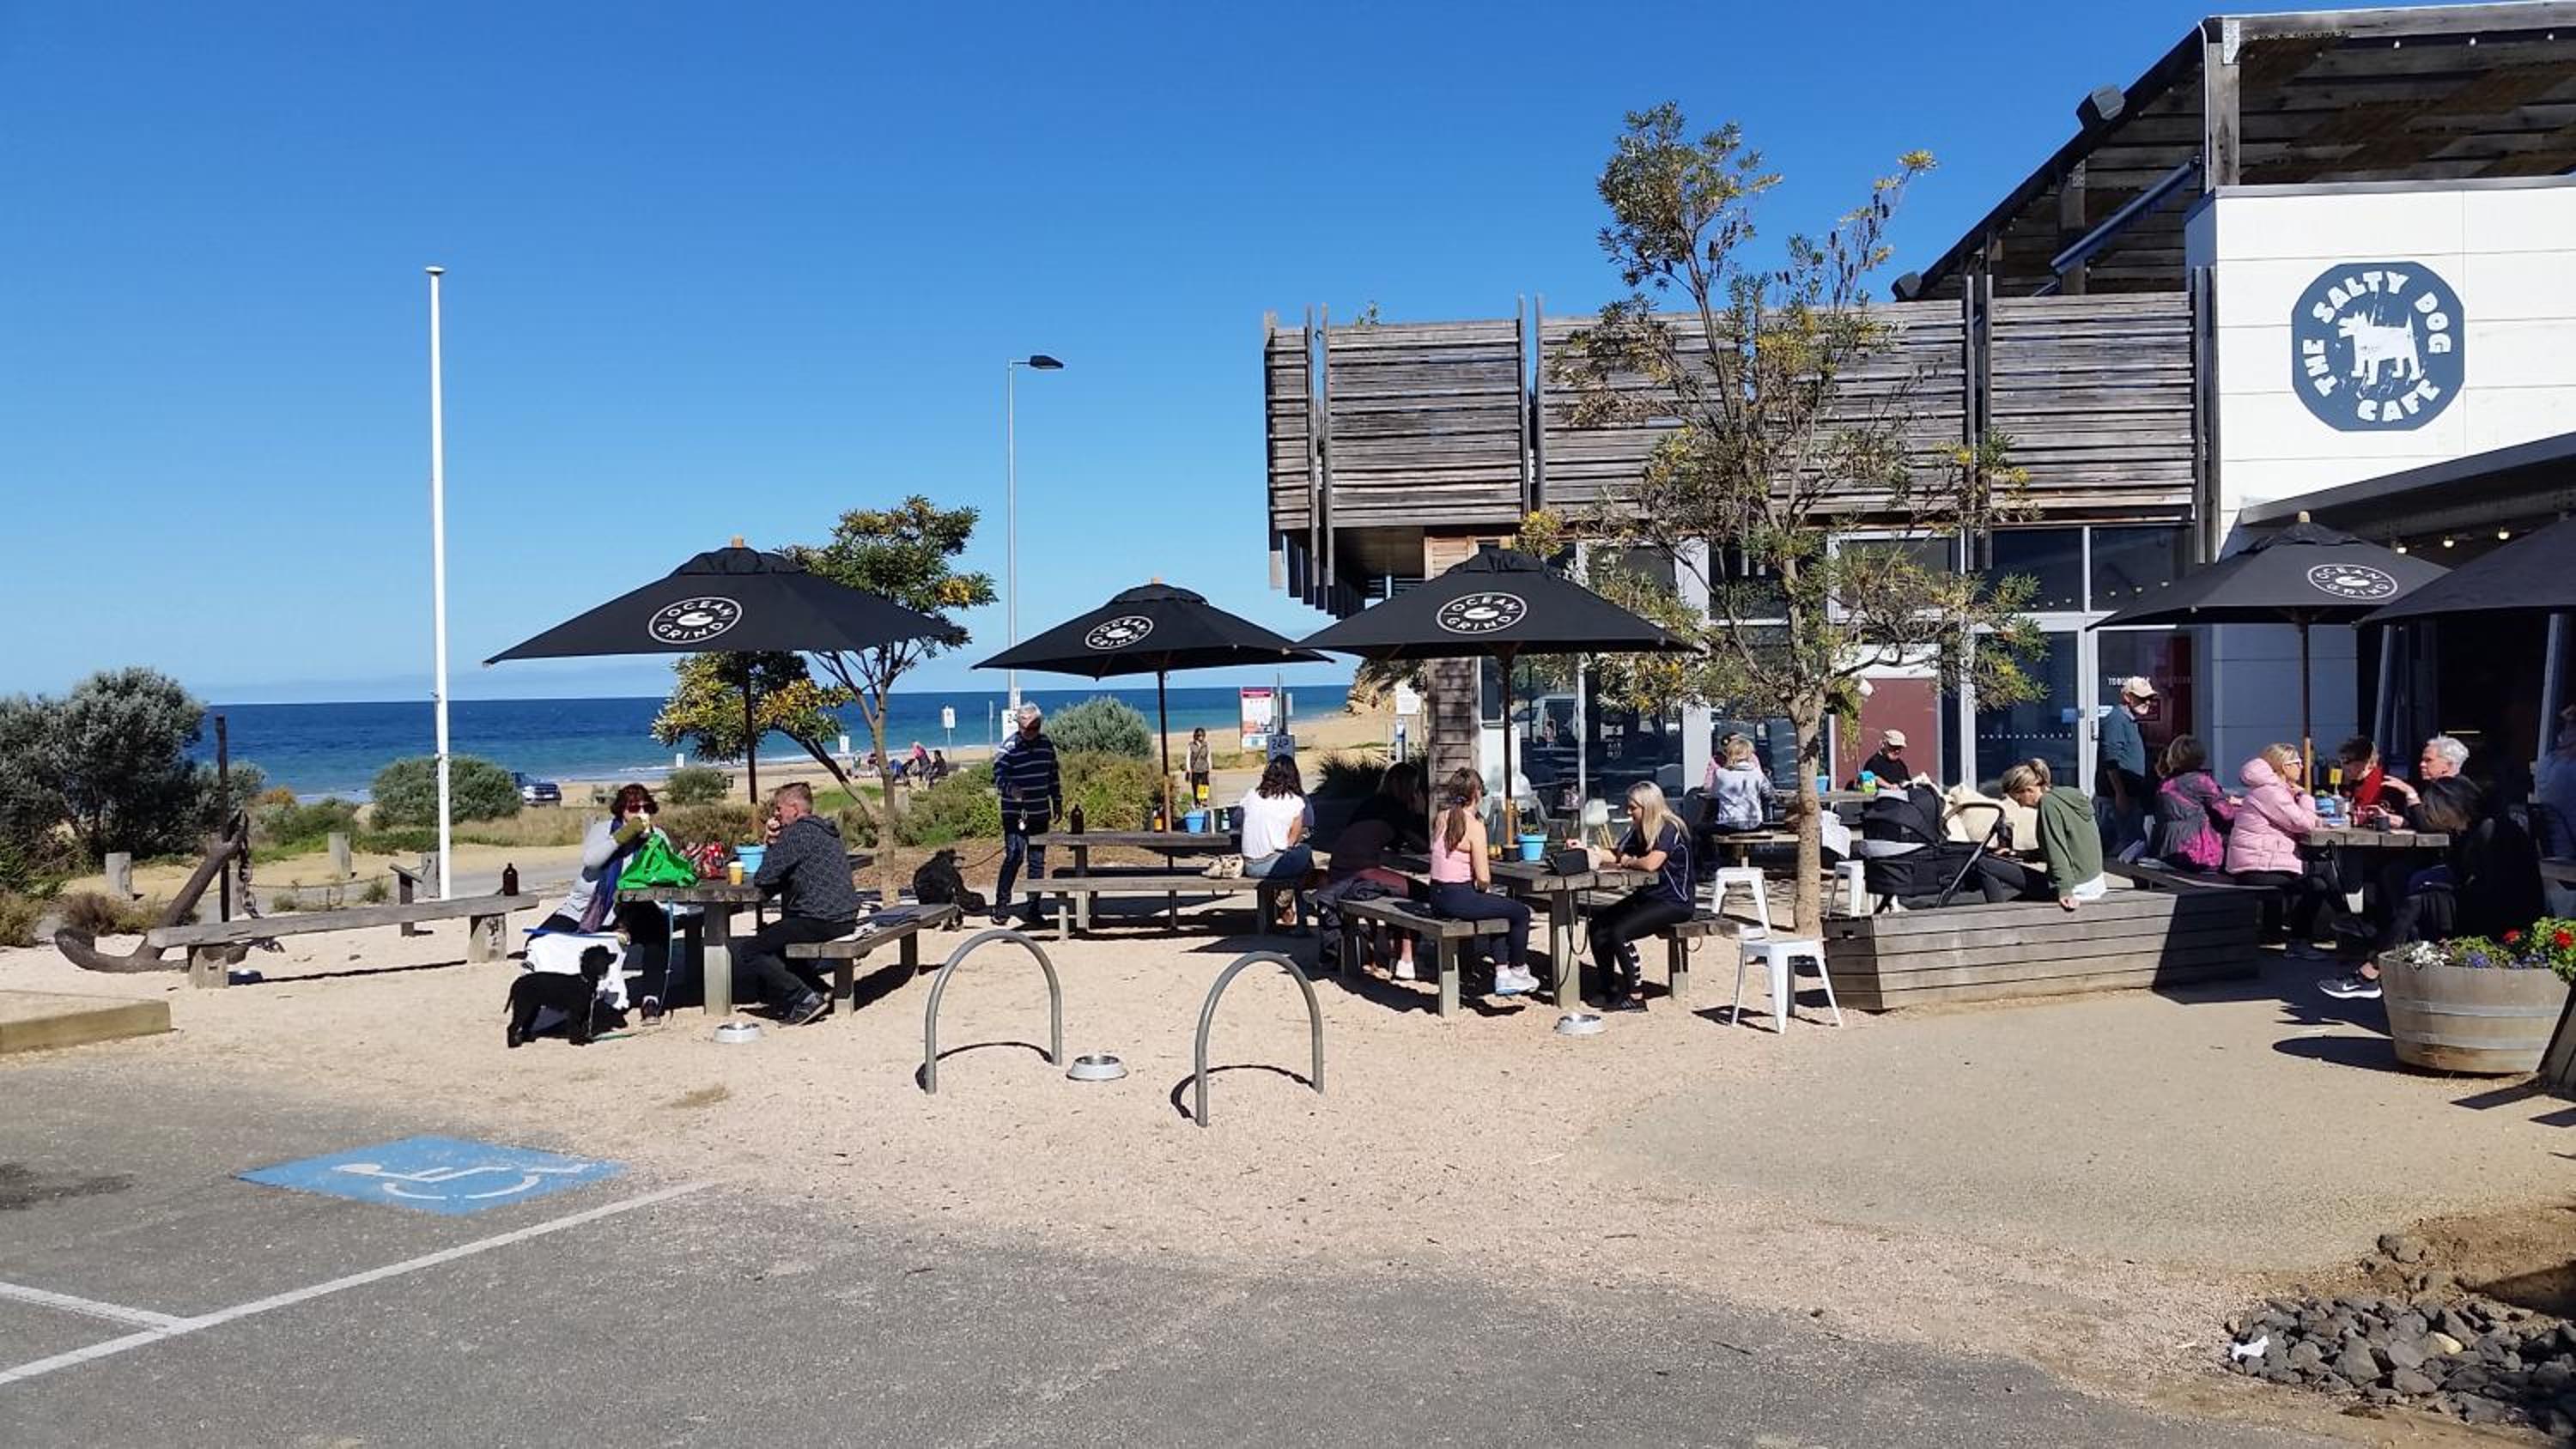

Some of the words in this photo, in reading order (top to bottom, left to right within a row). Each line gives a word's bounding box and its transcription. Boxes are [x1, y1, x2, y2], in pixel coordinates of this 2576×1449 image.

[2312, 270, 2409, 324] SALTY
[2415, 291, 2451, 354] DOG
[2302, 339, 2337, 397] THE
[2357, 379, 2440, 421] CAFE
[667, 601, 734, 616] OCEAN
[1451, 596, 1519, 610] OCEAN
[658, 622, 724, 639] GRIND
[1447, 615, 1511, 631] GRIND
